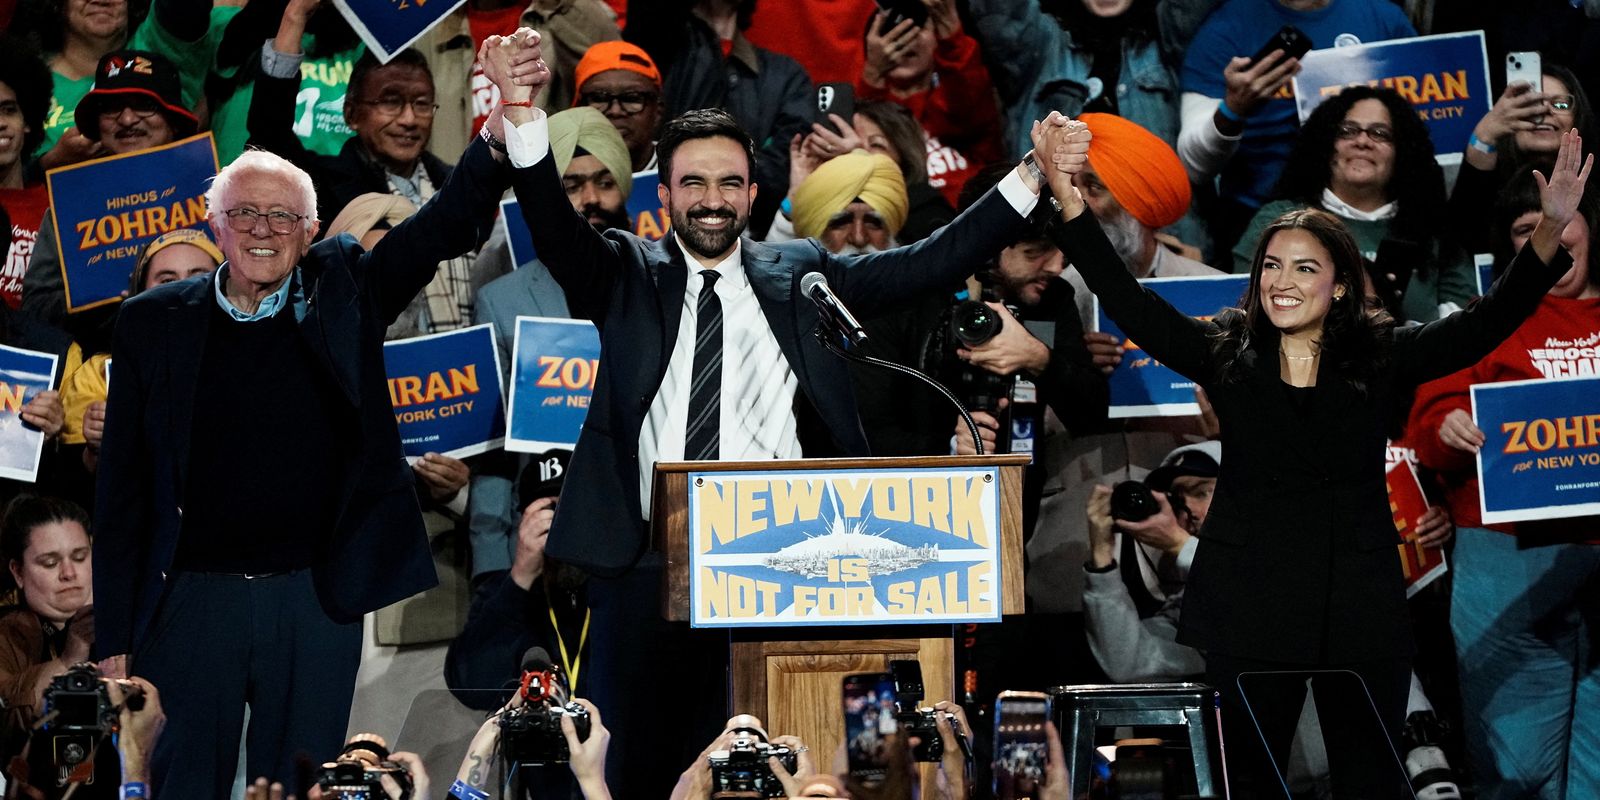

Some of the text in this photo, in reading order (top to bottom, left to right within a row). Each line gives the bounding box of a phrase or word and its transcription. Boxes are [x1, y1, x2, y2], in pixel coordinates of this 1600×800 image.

[1431, 106, 1464, 120] CITY
[106, 190, 158, 210] HINDUS
[76, 194, 208, 251] ZOHRAN
[106, 244, 138, 260] NEW
[395, 400, 474, 424] YORK CITY
[1537, 455, 1574, 470] NEW
[699, 475, 990, 555] NEW YORK
[827, 557, 870, 583] IS
[700, 559, 993, 619] NOT FOR SALE
